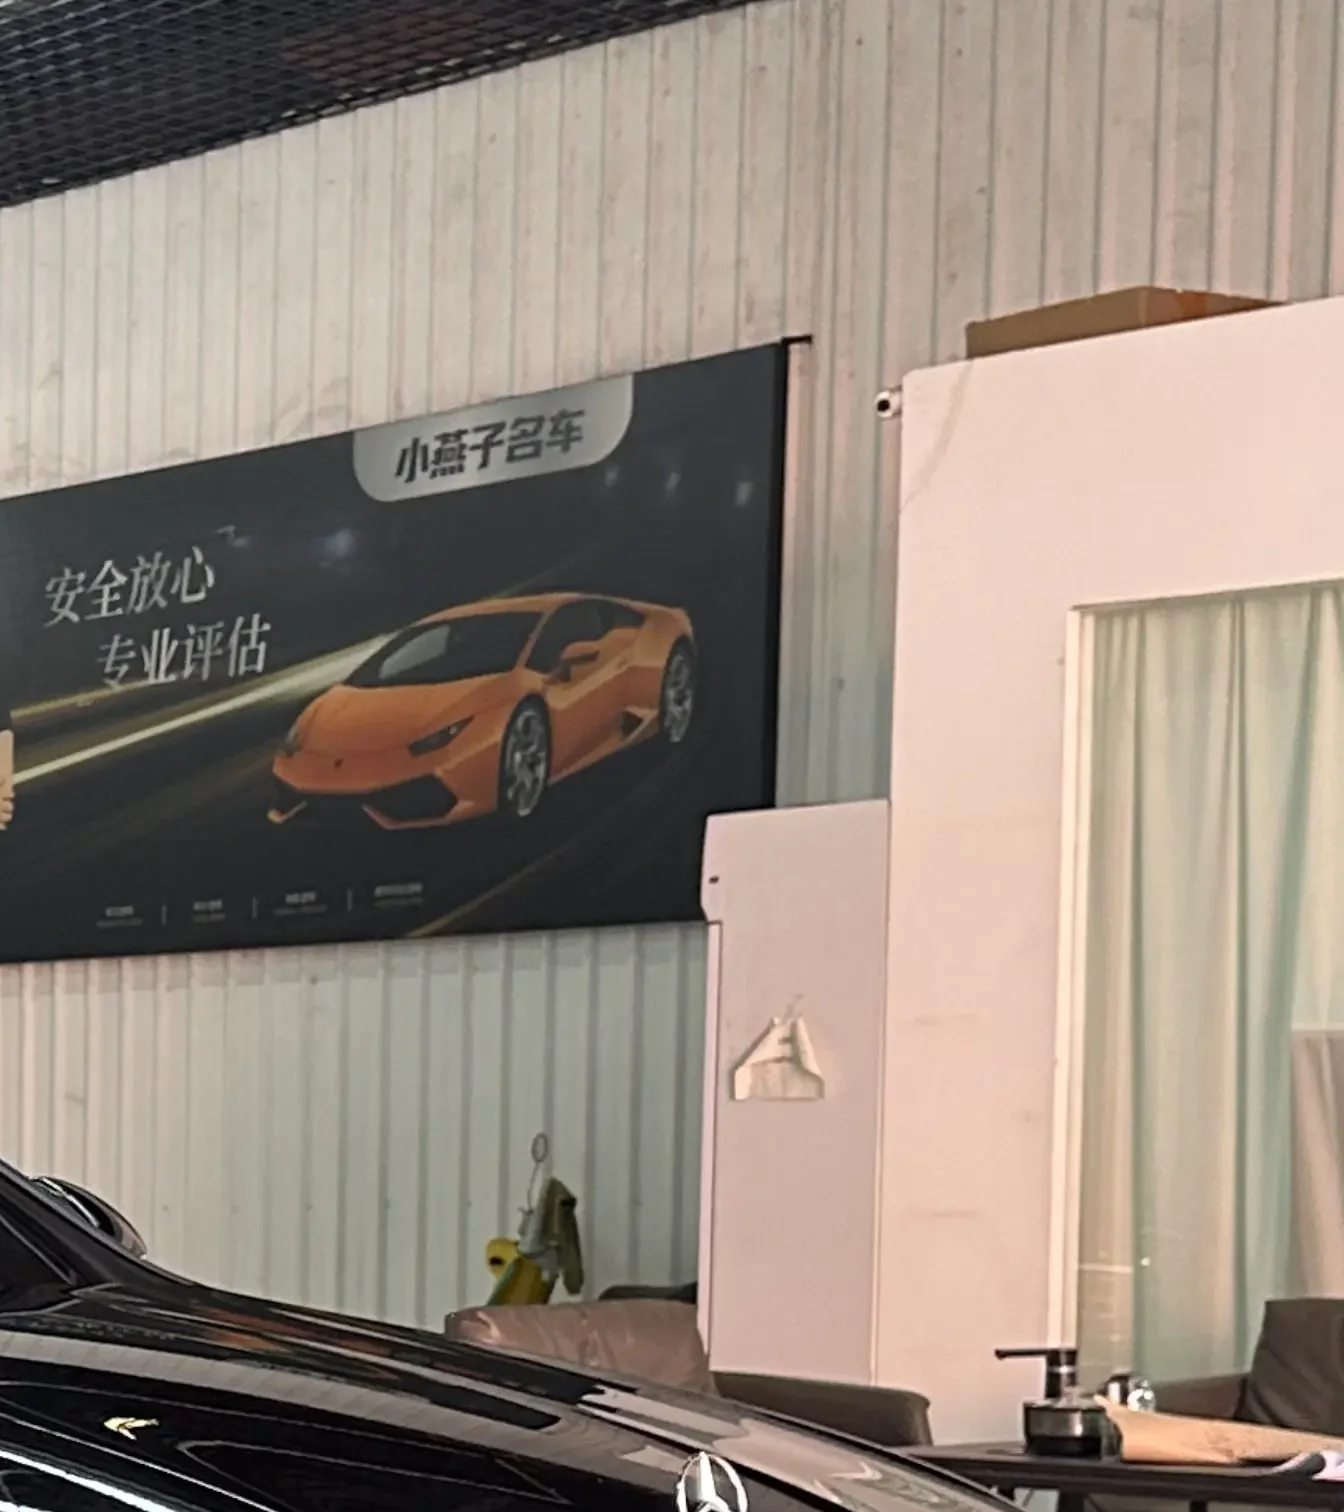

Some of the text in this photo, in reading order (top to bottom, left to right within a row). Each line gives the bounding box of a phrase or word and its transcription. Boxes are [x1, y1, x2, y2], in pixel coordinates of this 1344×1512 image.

[395, 409, 585, 483] 小燕子名车
[43, 545, 216, 628] 安全放心
[96, 613, 271, 687] 专业评估
